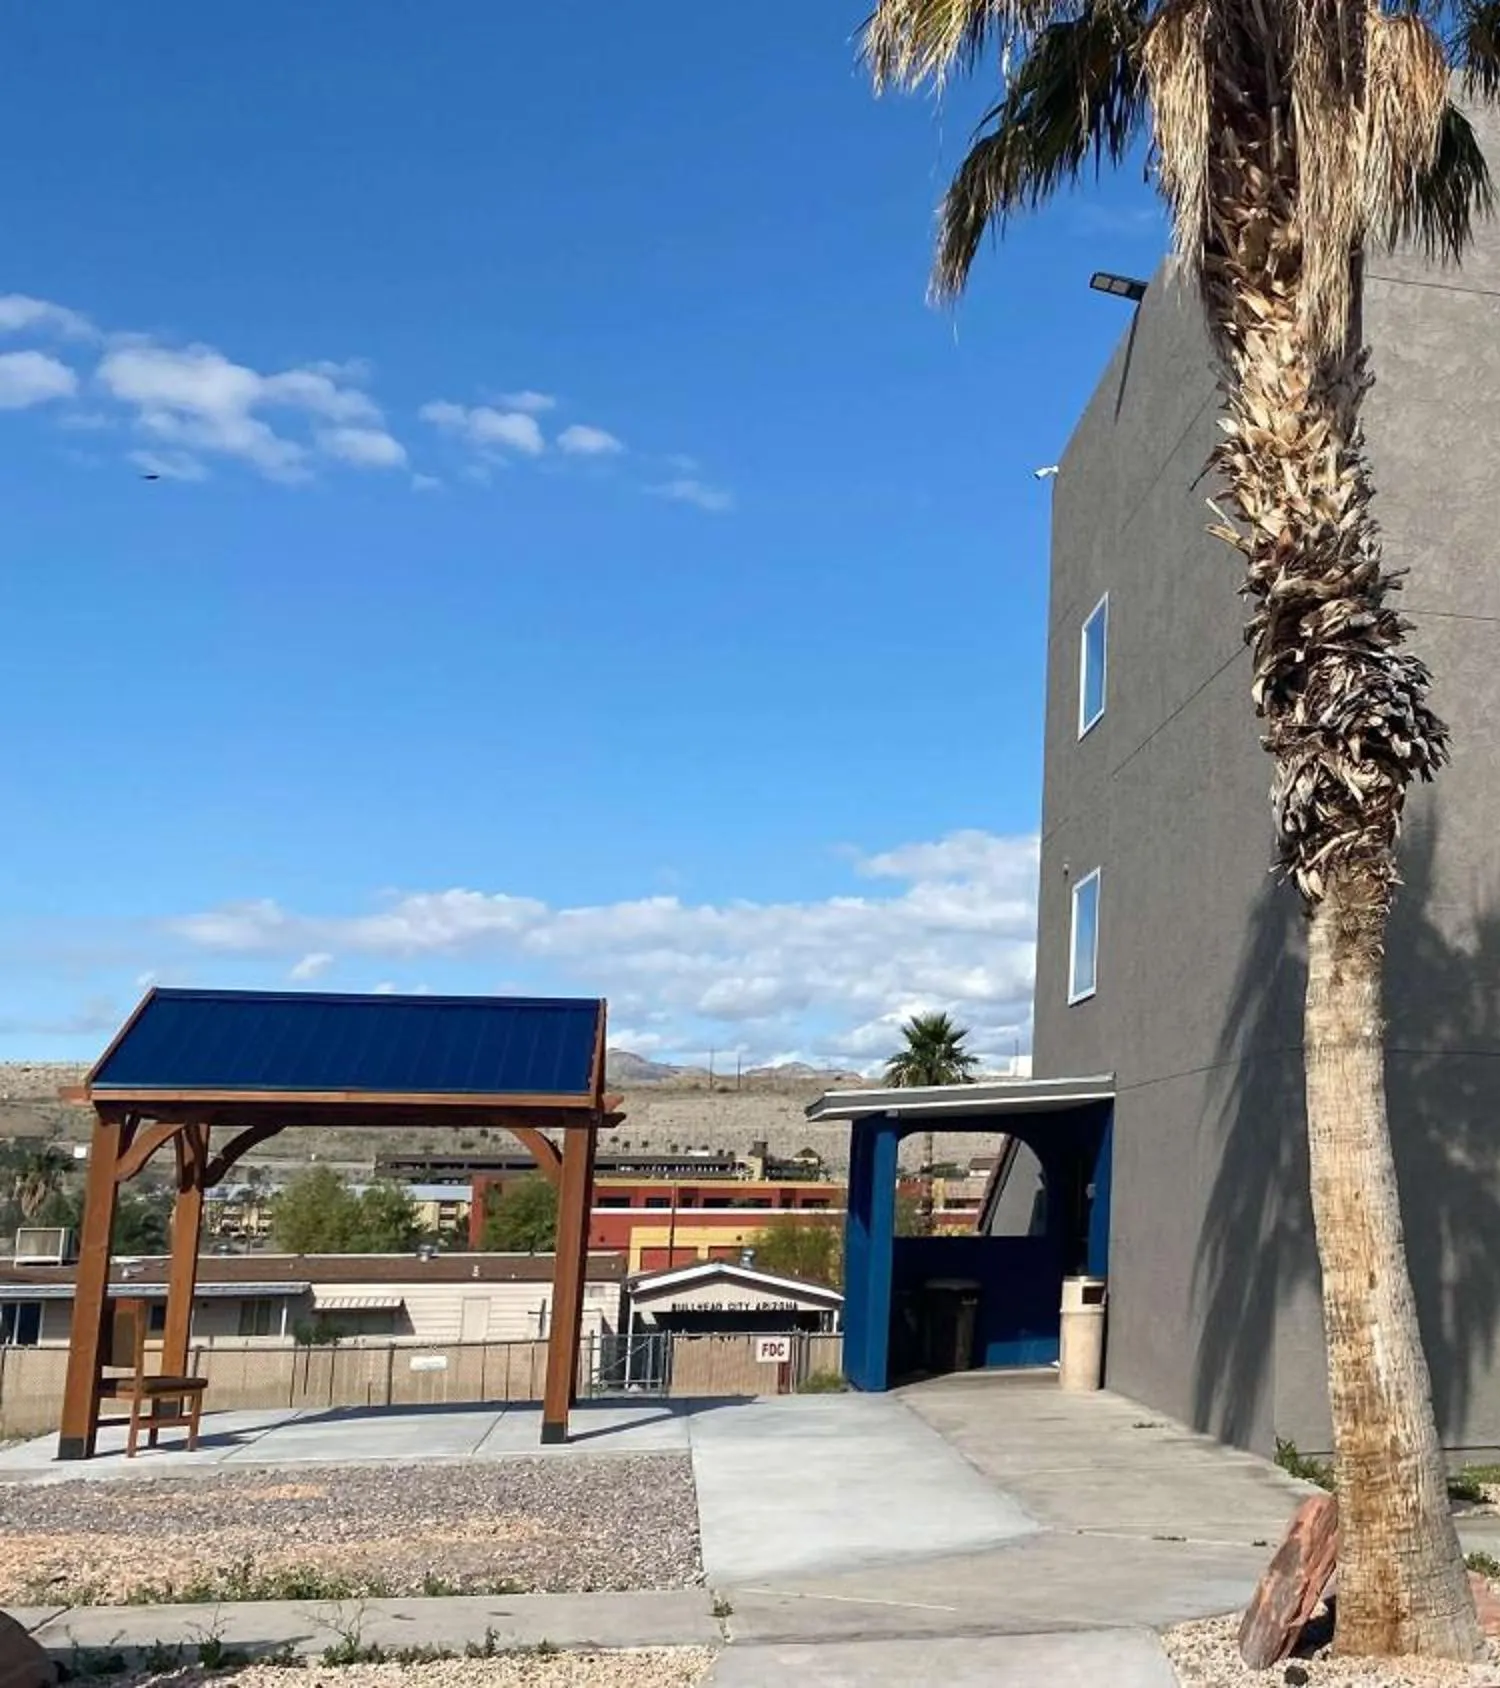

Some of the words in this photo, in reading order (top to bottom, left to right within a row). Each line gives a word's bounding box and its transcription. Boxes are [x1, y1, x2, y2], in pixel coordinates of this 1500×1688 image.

[728, 1301, 750, 1312] CITY
[755, 1301, 798, 1312] ARIZONA
[761, 1343, 785, 1357] FDC
